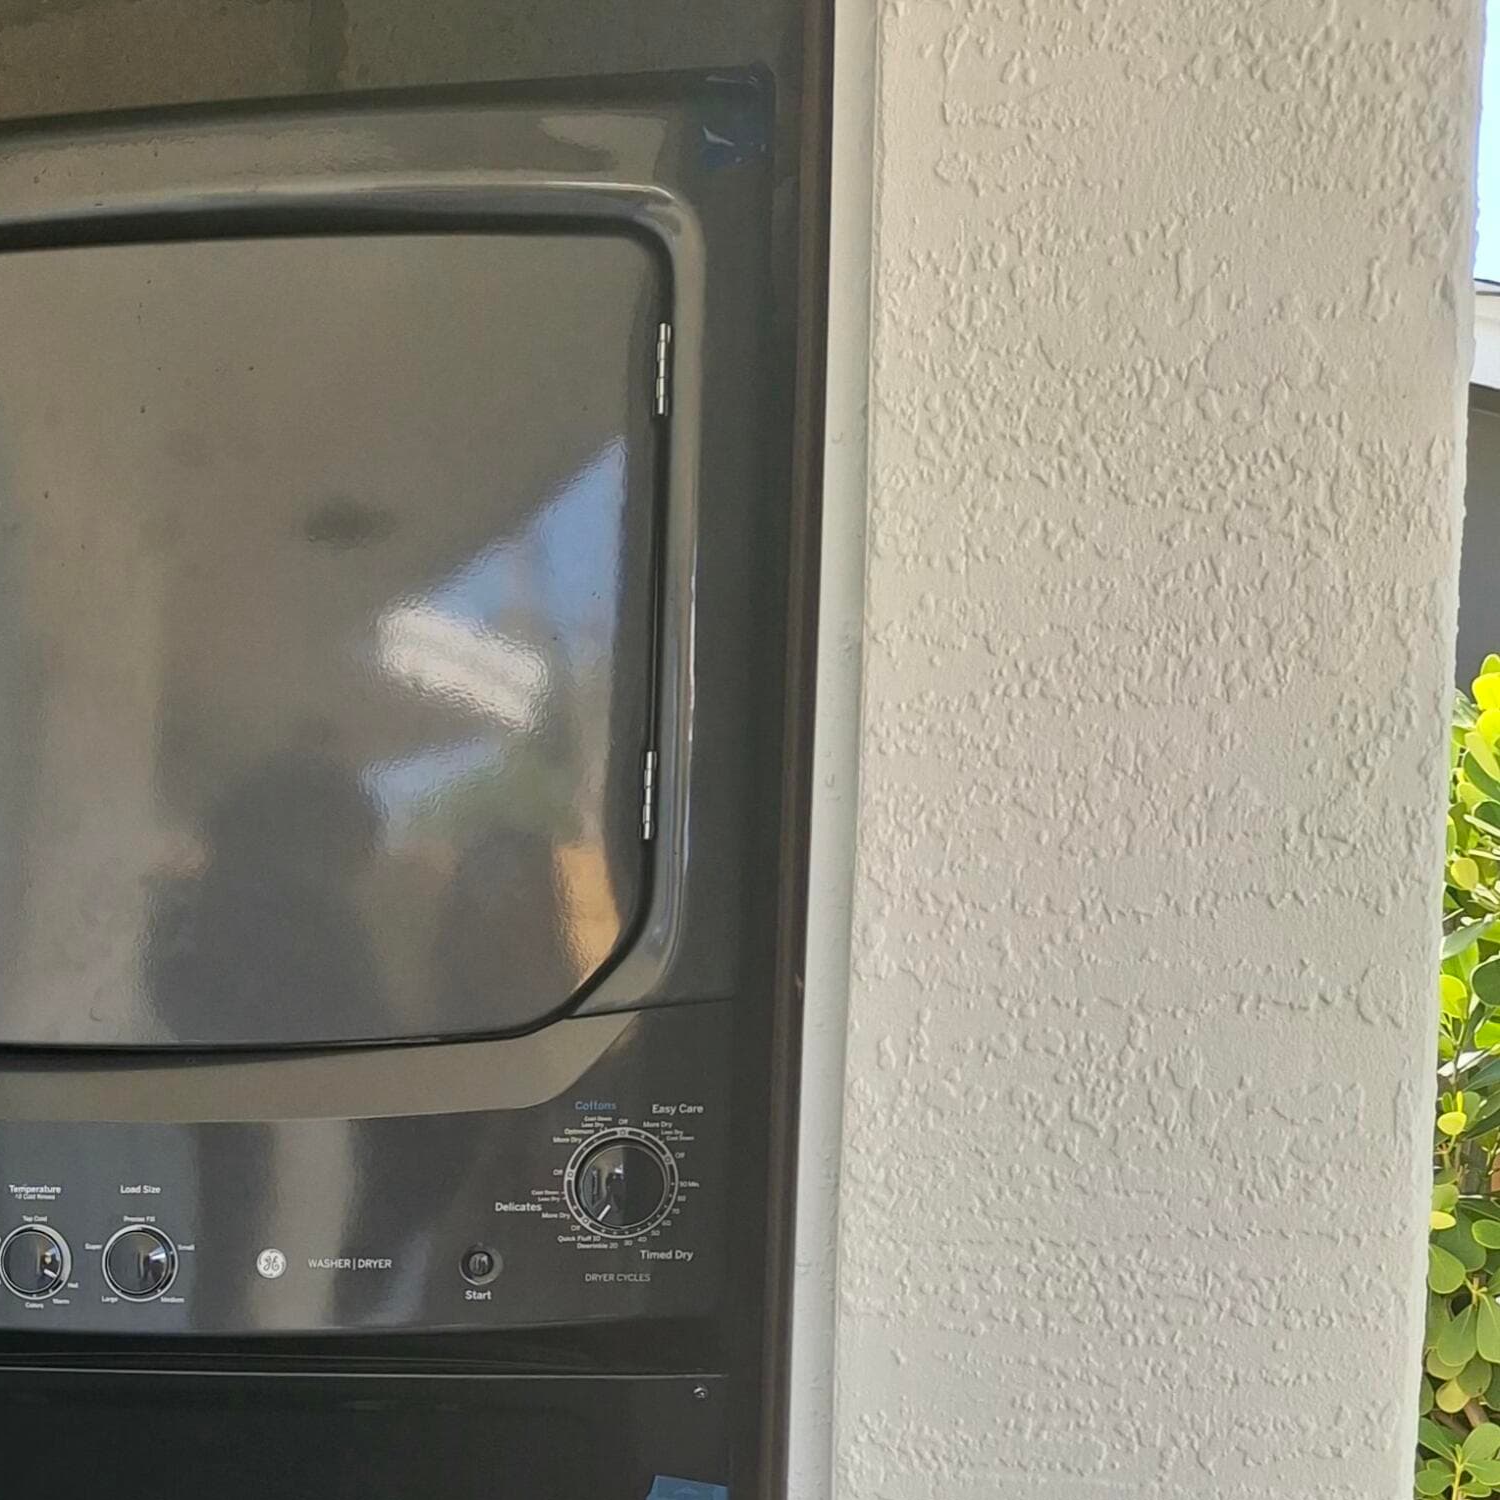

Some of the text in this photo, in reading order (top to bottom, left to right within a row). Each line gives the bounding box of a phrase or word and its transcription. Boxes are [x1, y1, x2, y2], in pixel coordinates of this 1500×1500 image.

[575, 1101, 617, 1111] Cottons
[652, 1104, 704, 1115] Easy Care
[659, 1121, 672, 1129] Dry
[9, 1185, 61, 1195] Temperature
[120, 1185, 161, 1194] Load Size
[495, 1202, 542, 1212] Delicates
[558, 1212, 570, 1220] Dry
[640, 1251, 693, 1262] Timed Dry
[308, 1259, 392, 1269] WASHER DRYER
[585, 1273, 651, 1282] DRYER CYCLES
[102, 1296, 118, 1304] Large
[465, 1290, 492, 1300] Start
